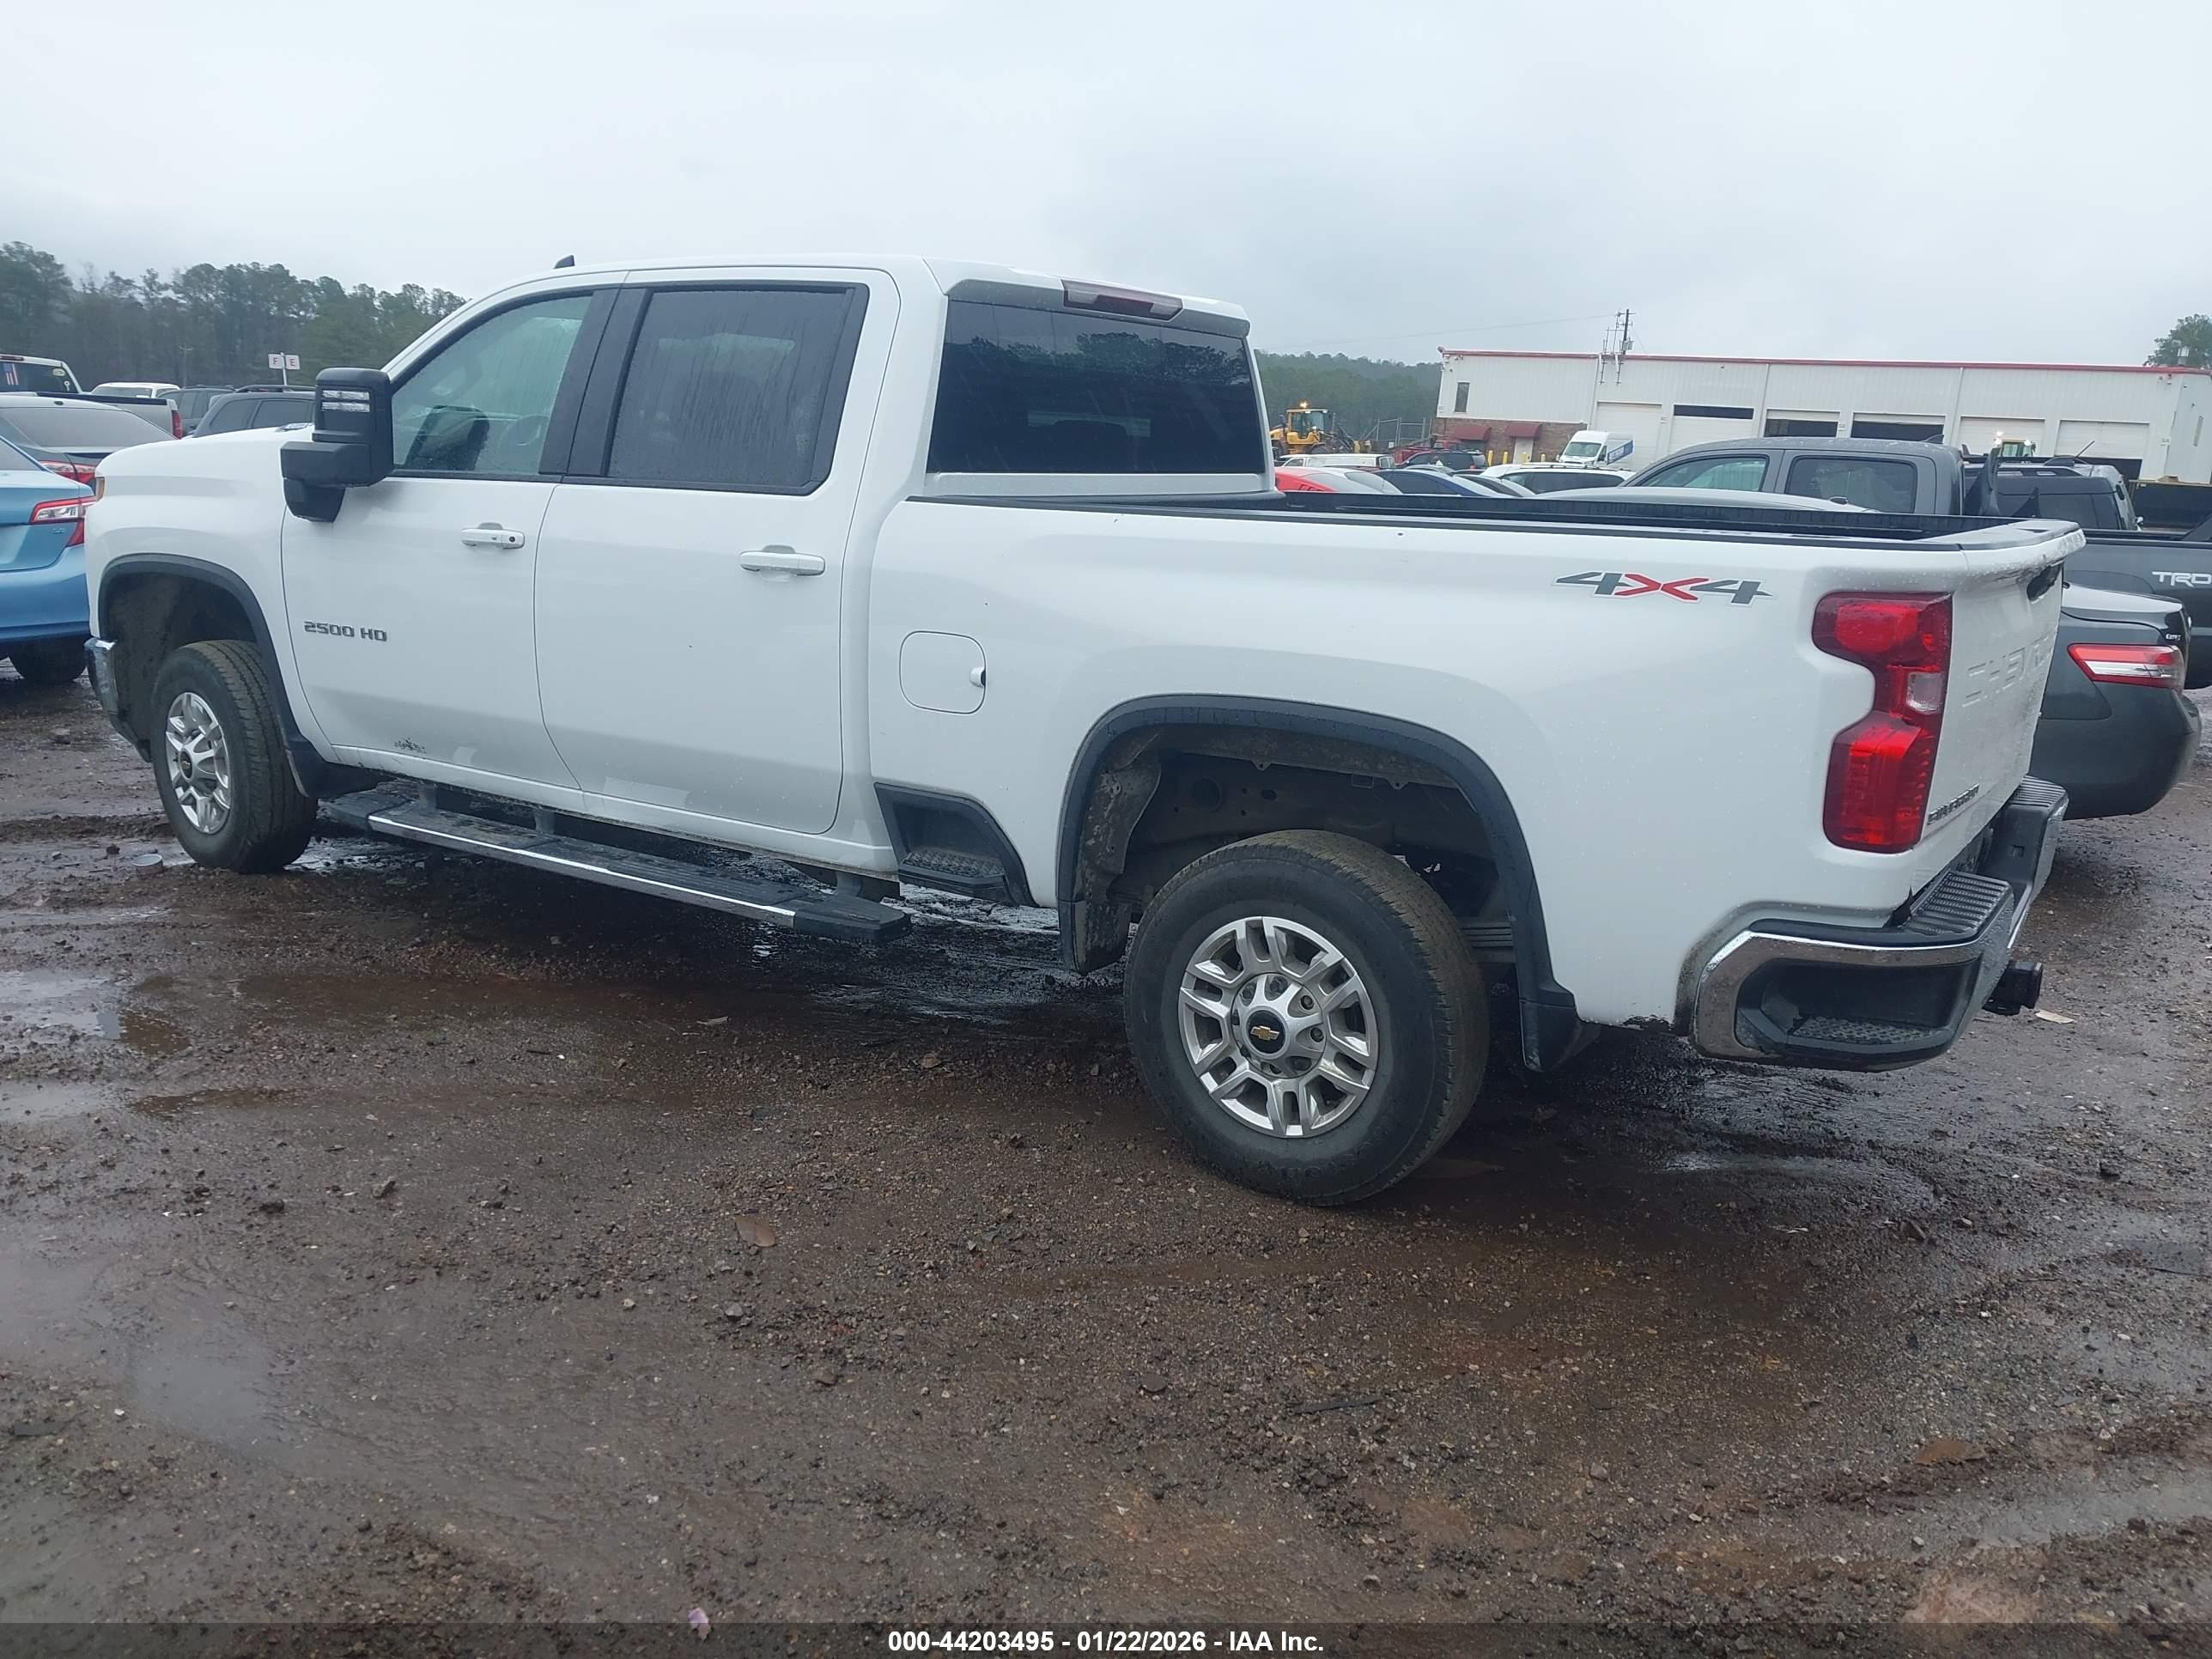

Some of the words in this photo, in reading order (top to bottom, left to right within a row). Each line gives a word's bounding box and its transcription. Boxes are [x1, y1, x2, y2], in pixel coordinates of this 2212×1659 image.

[2151, 571, 2212, 587] TRD
[303, 621, 355, 637] 2500
[360, 627, 387, 641] HD
